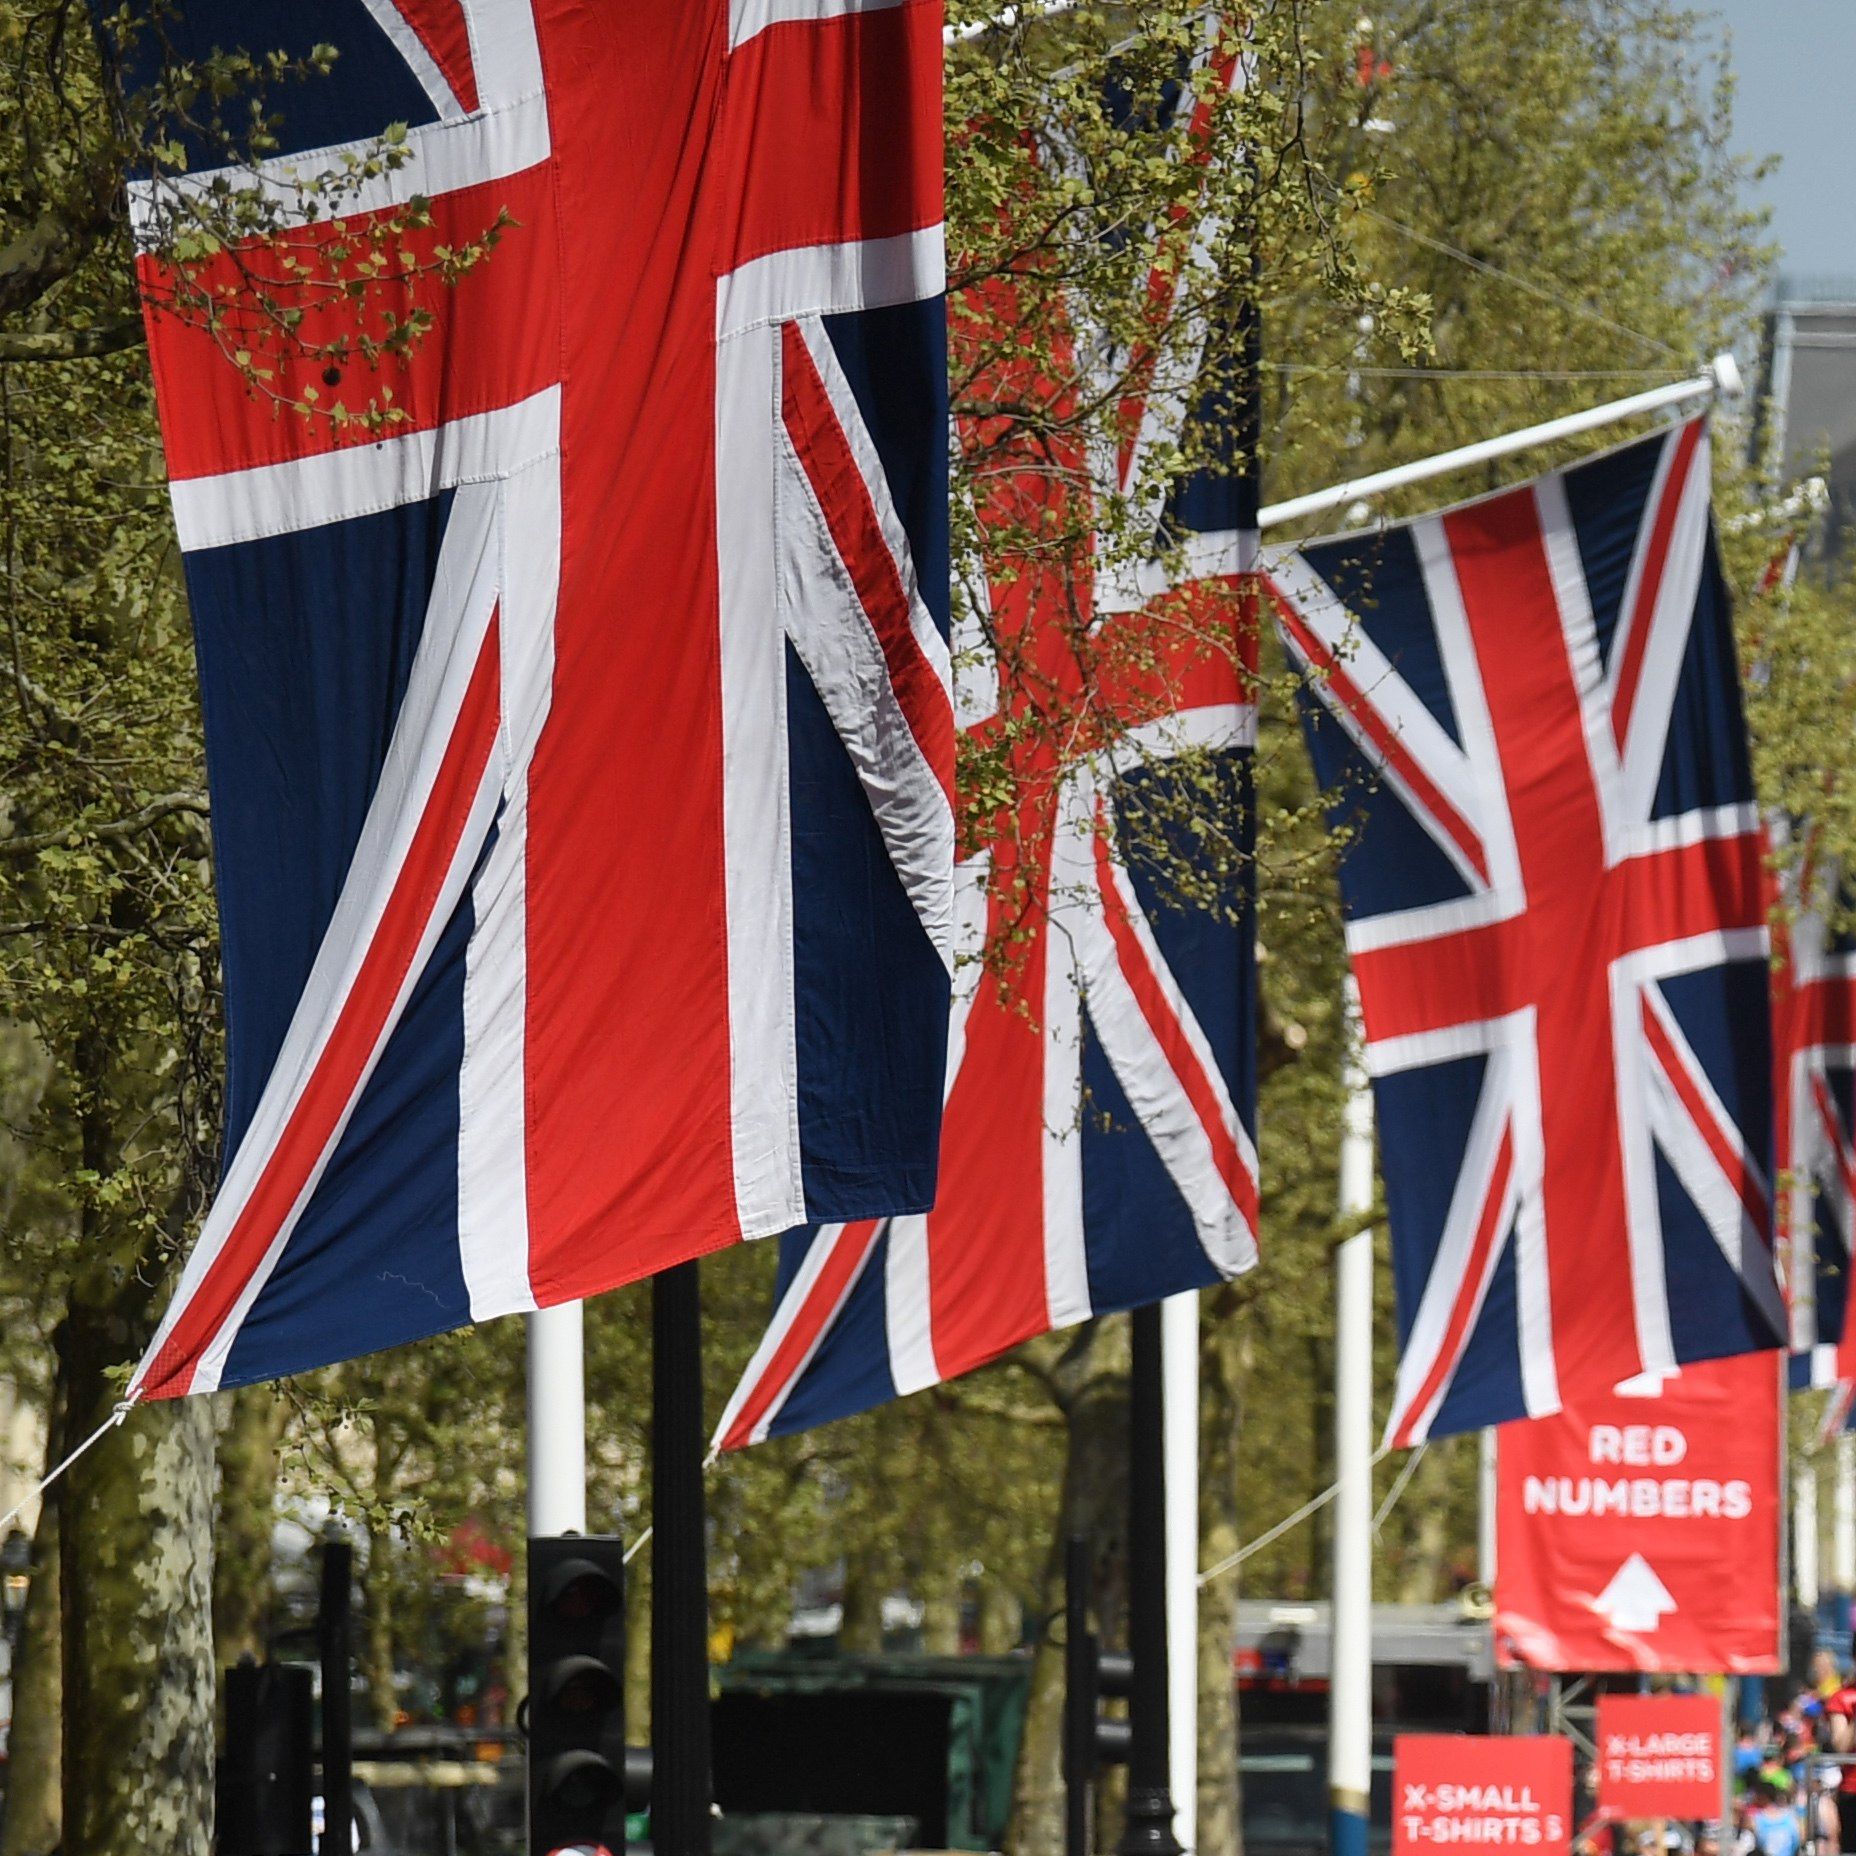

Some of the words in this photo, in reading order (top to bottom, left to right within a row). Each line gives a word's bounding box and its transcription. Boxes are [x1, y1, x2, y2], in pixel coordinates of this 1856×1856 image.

[1590, 1426, 1687, 1466] RED
[1524, 1476, 1752, 1518] NUMBERS
[1606, 1733, 1712, 1758] X-LARGE
[1606, 1758, 1715, 1783] T-SHIRTS
[1404, 1784, 1540, 1812] X-SMALL
[1403, 1816, 1541, 1844] T-SHIRTS
